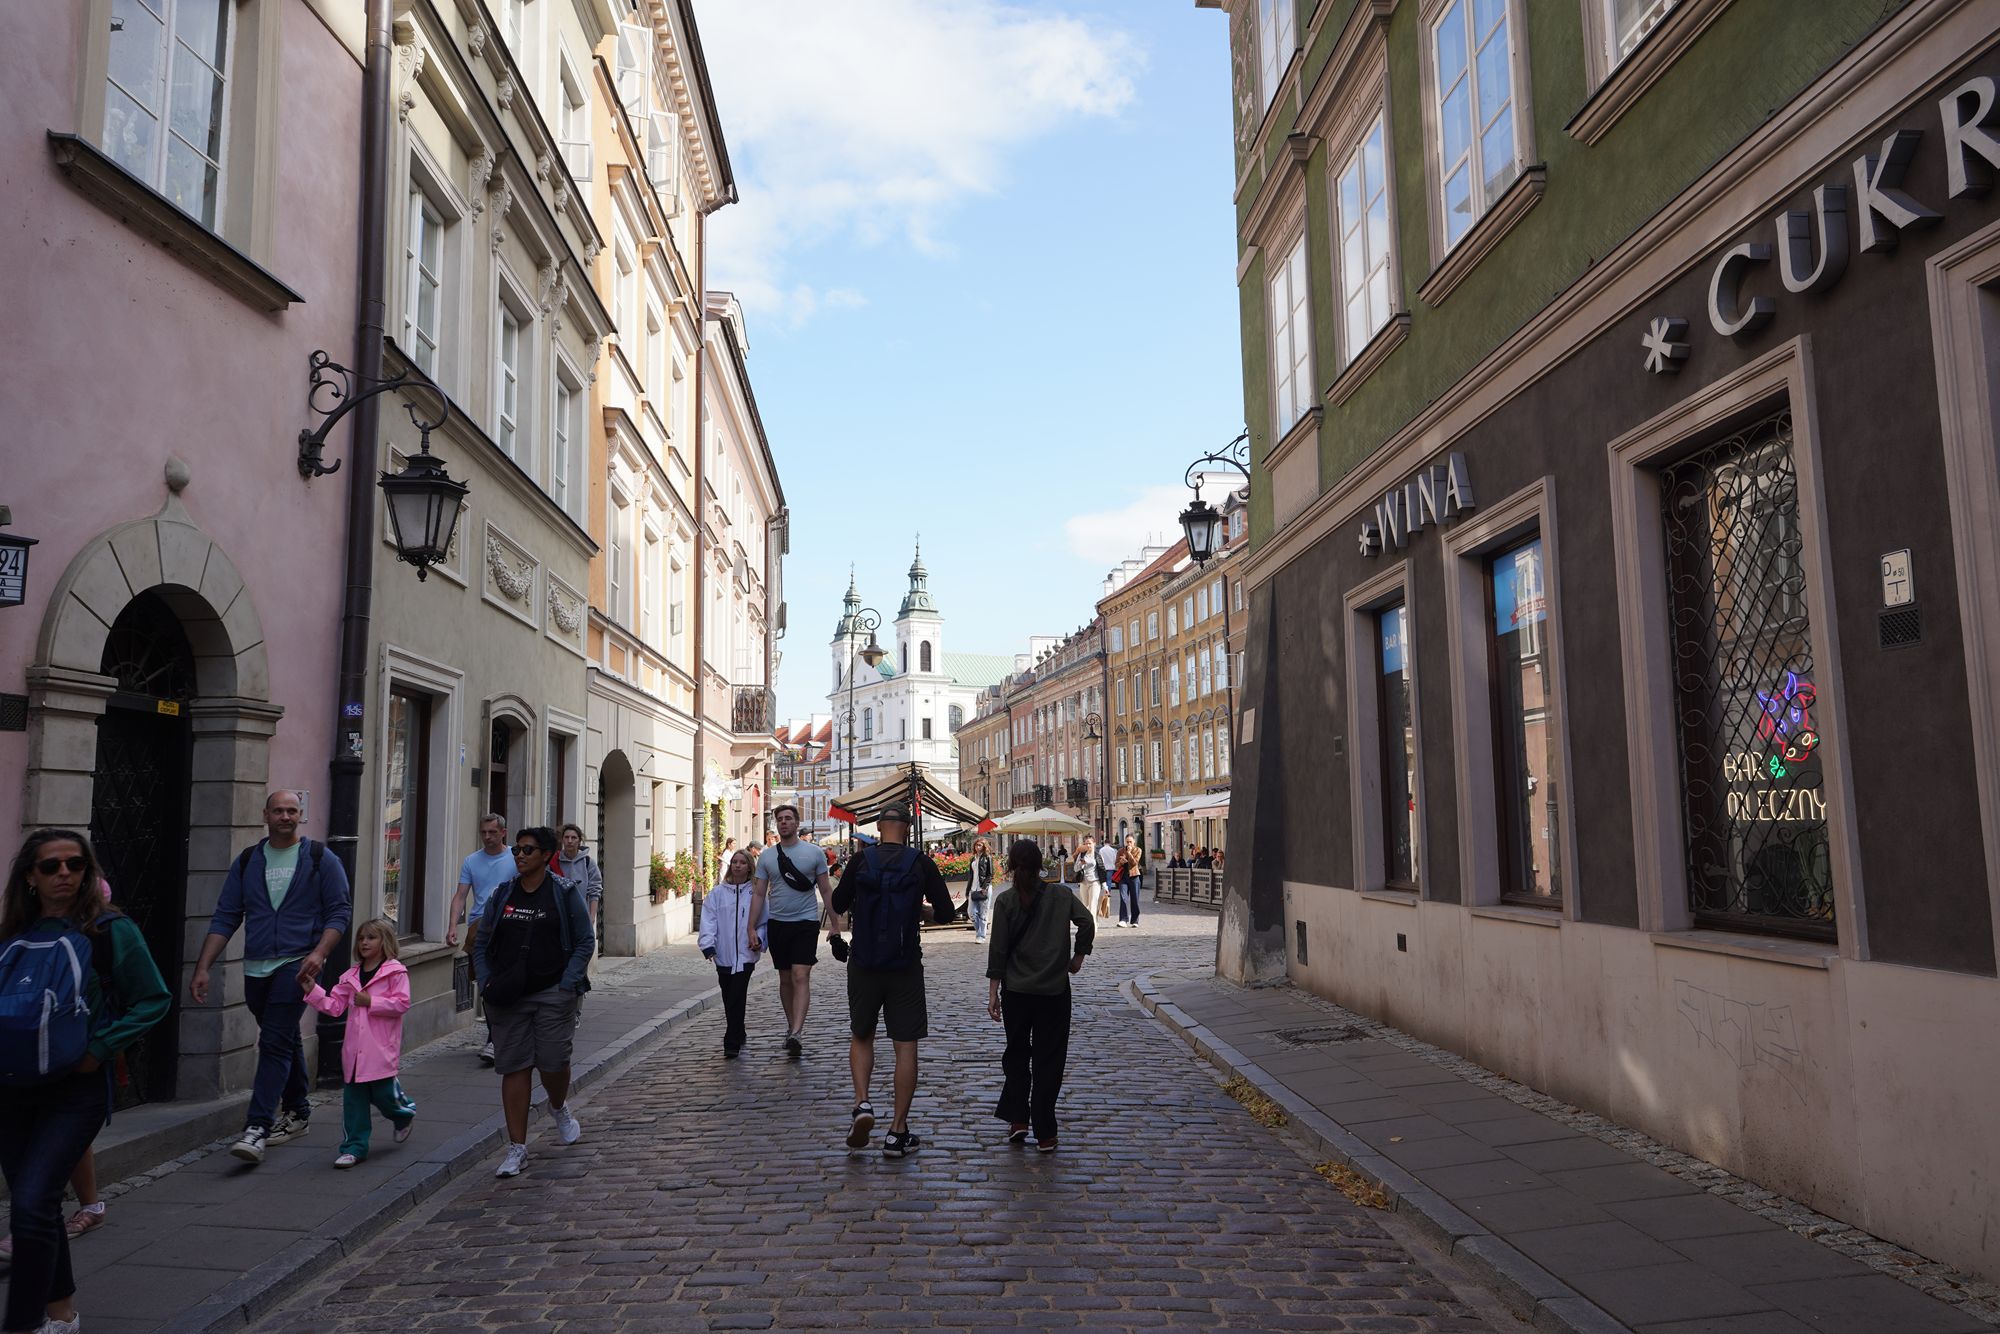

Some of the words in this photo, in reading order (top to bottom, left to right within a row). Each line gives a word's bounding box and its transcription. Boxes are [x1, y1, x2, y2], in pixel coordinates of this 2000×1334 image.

[1375, 452, 1474, 554] WINA
[1723, 751, 1767, 782] BAR
[1727, 788, 1827, 821] MLECZNY
